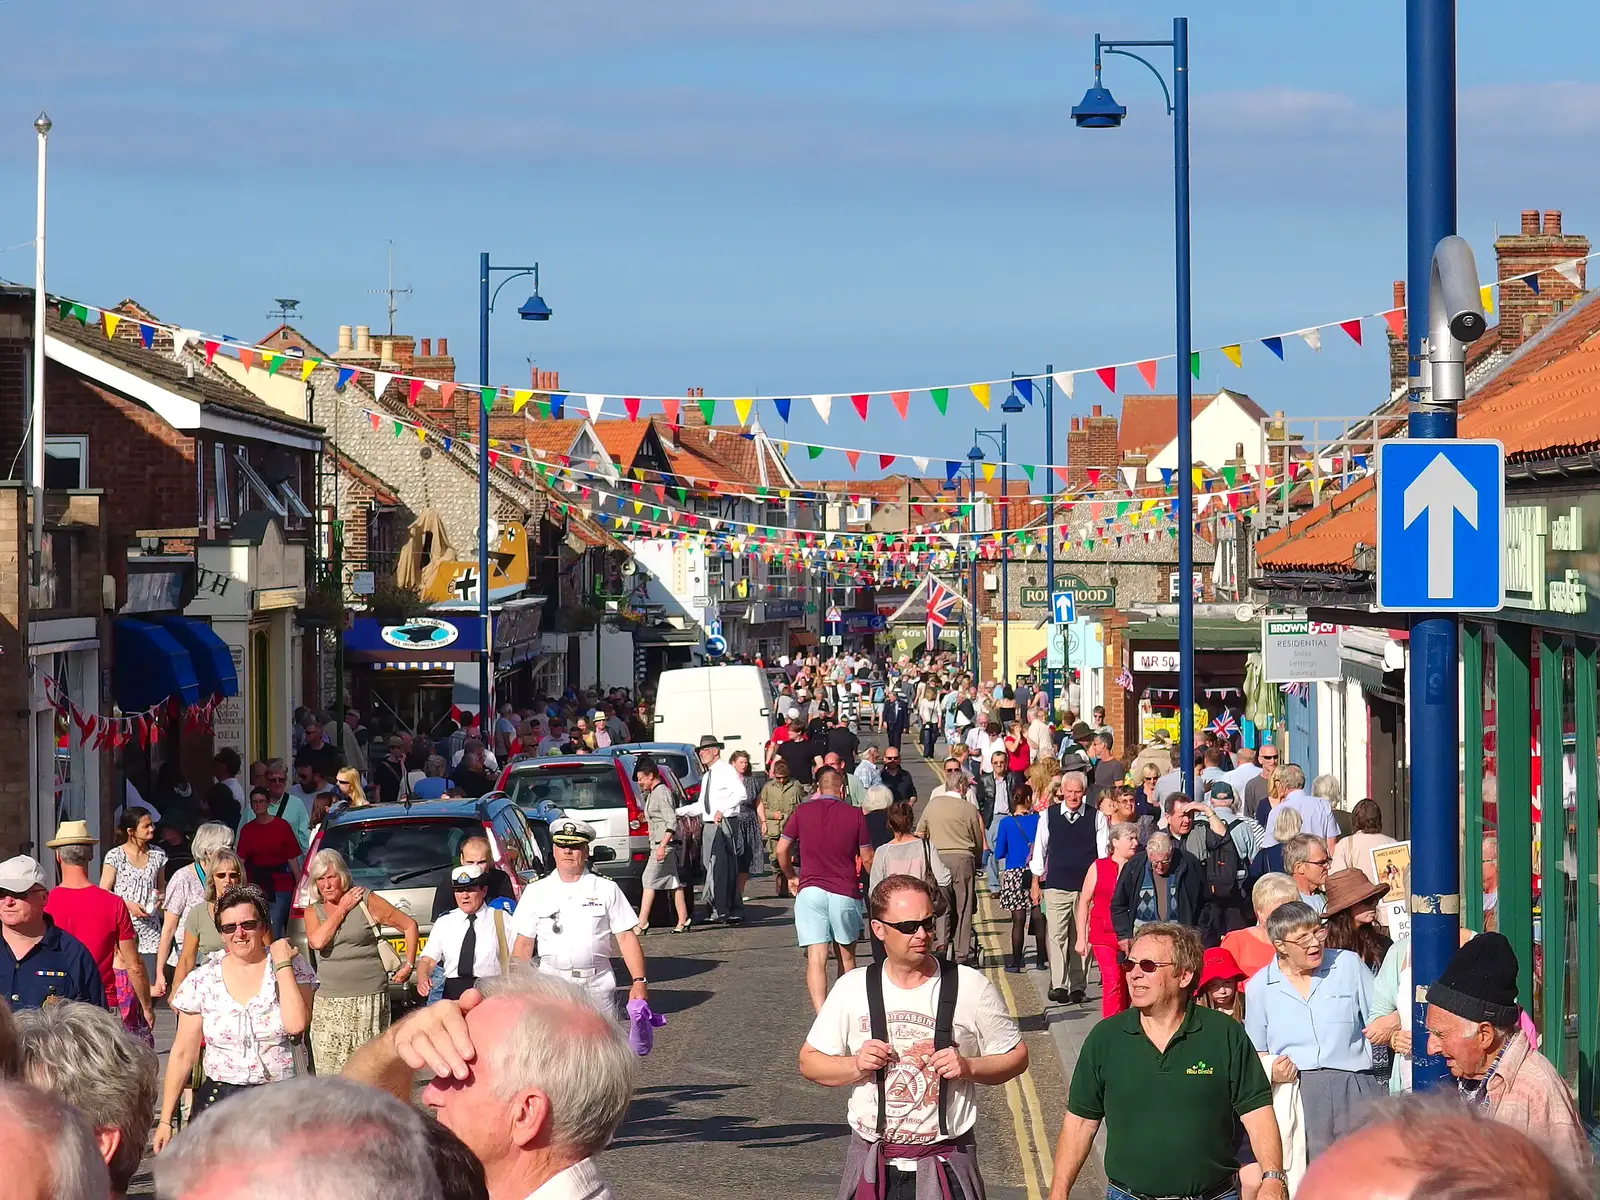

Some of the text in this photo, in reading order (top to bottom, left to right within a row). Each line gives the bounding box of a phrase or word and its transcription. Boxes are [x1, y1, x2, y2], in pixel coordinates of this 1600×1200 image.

[1057, 579, 1077, 588] THE
[1277, 639, 1328, 648] RESIDENTIAL
[1050, 657, 1083, 667] phaacy
[1141, 656, 1175, 667] MR 50
[1289, 660, 1317, 668] Lettings
[217, 731, 240, 739] DELI
[1393, 905, 1407, 915] DV
